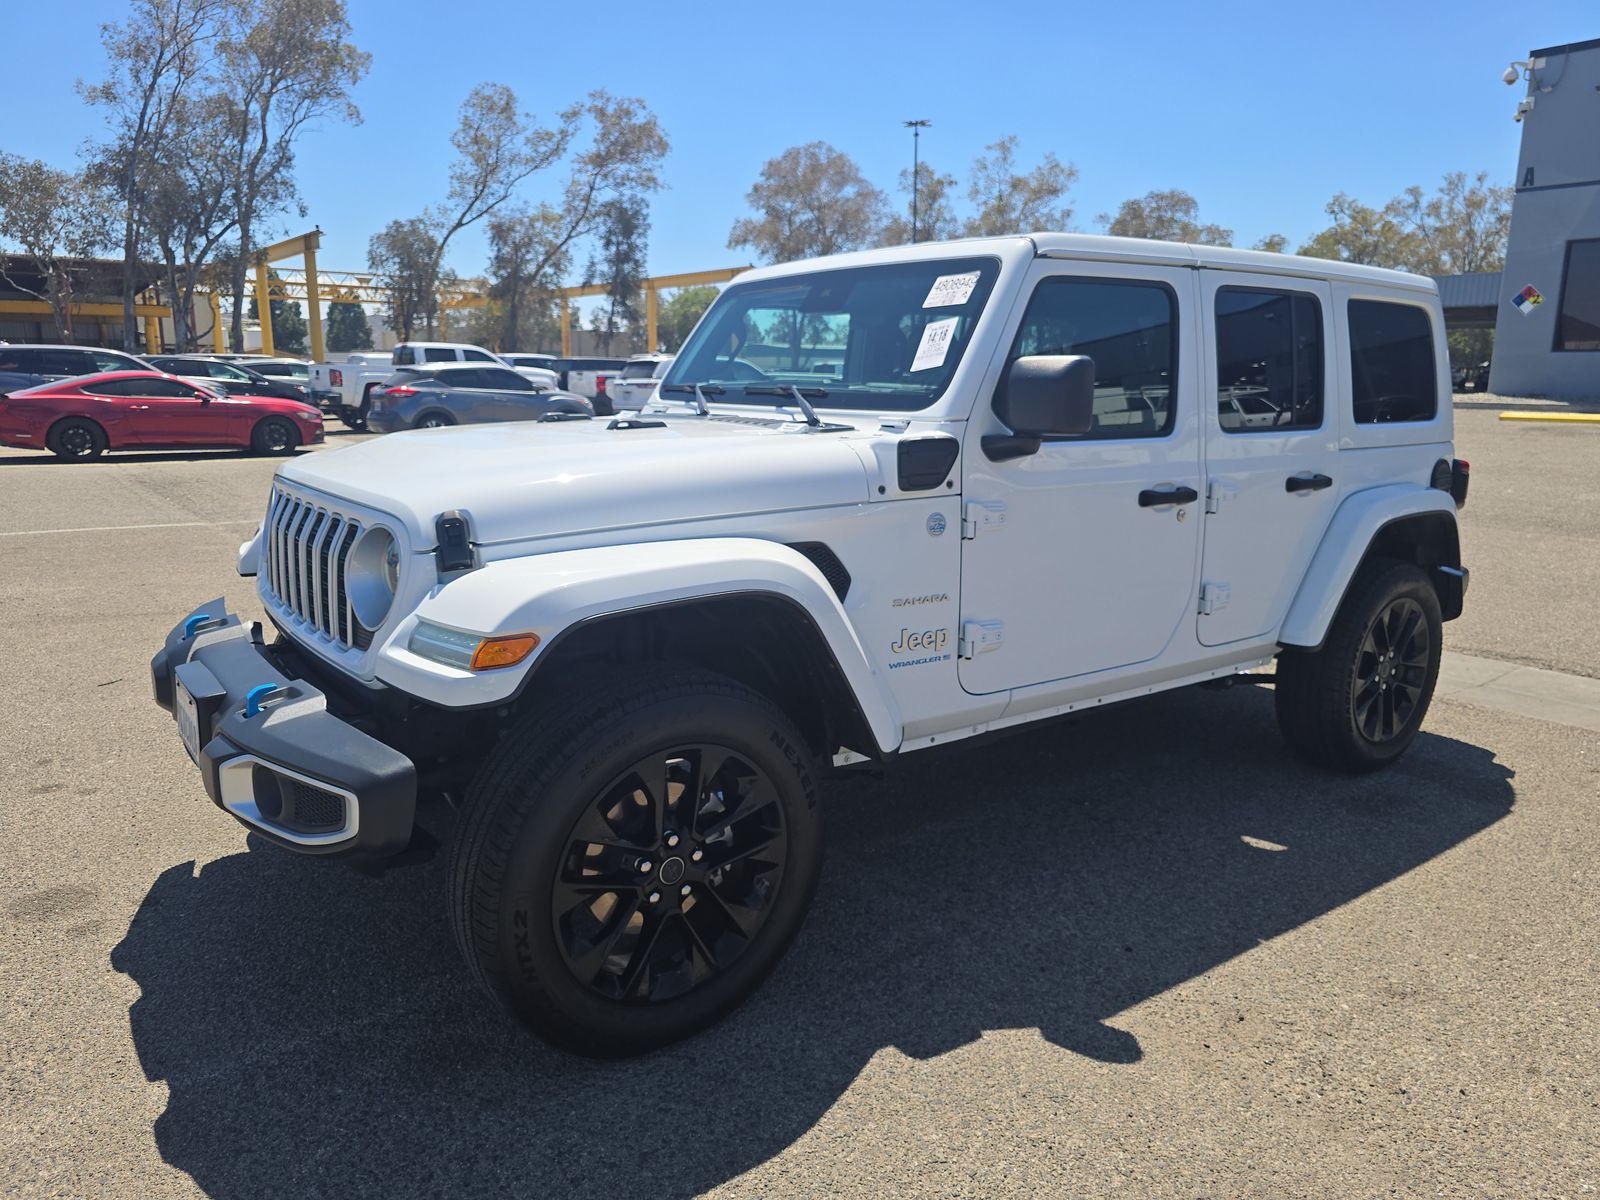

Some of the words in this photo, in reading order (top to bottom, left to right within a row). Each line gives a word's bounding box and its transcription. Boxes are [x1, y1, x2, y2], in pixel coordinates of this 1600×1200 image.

[1522, 167, 1535, 187] A
[892, 593, 949, 608] SAHARA
[891, 627, 950, 654] Jeep
[889, 656, 941, 669] WRANGLER
[769, 730, 817, 811] NEXEN
